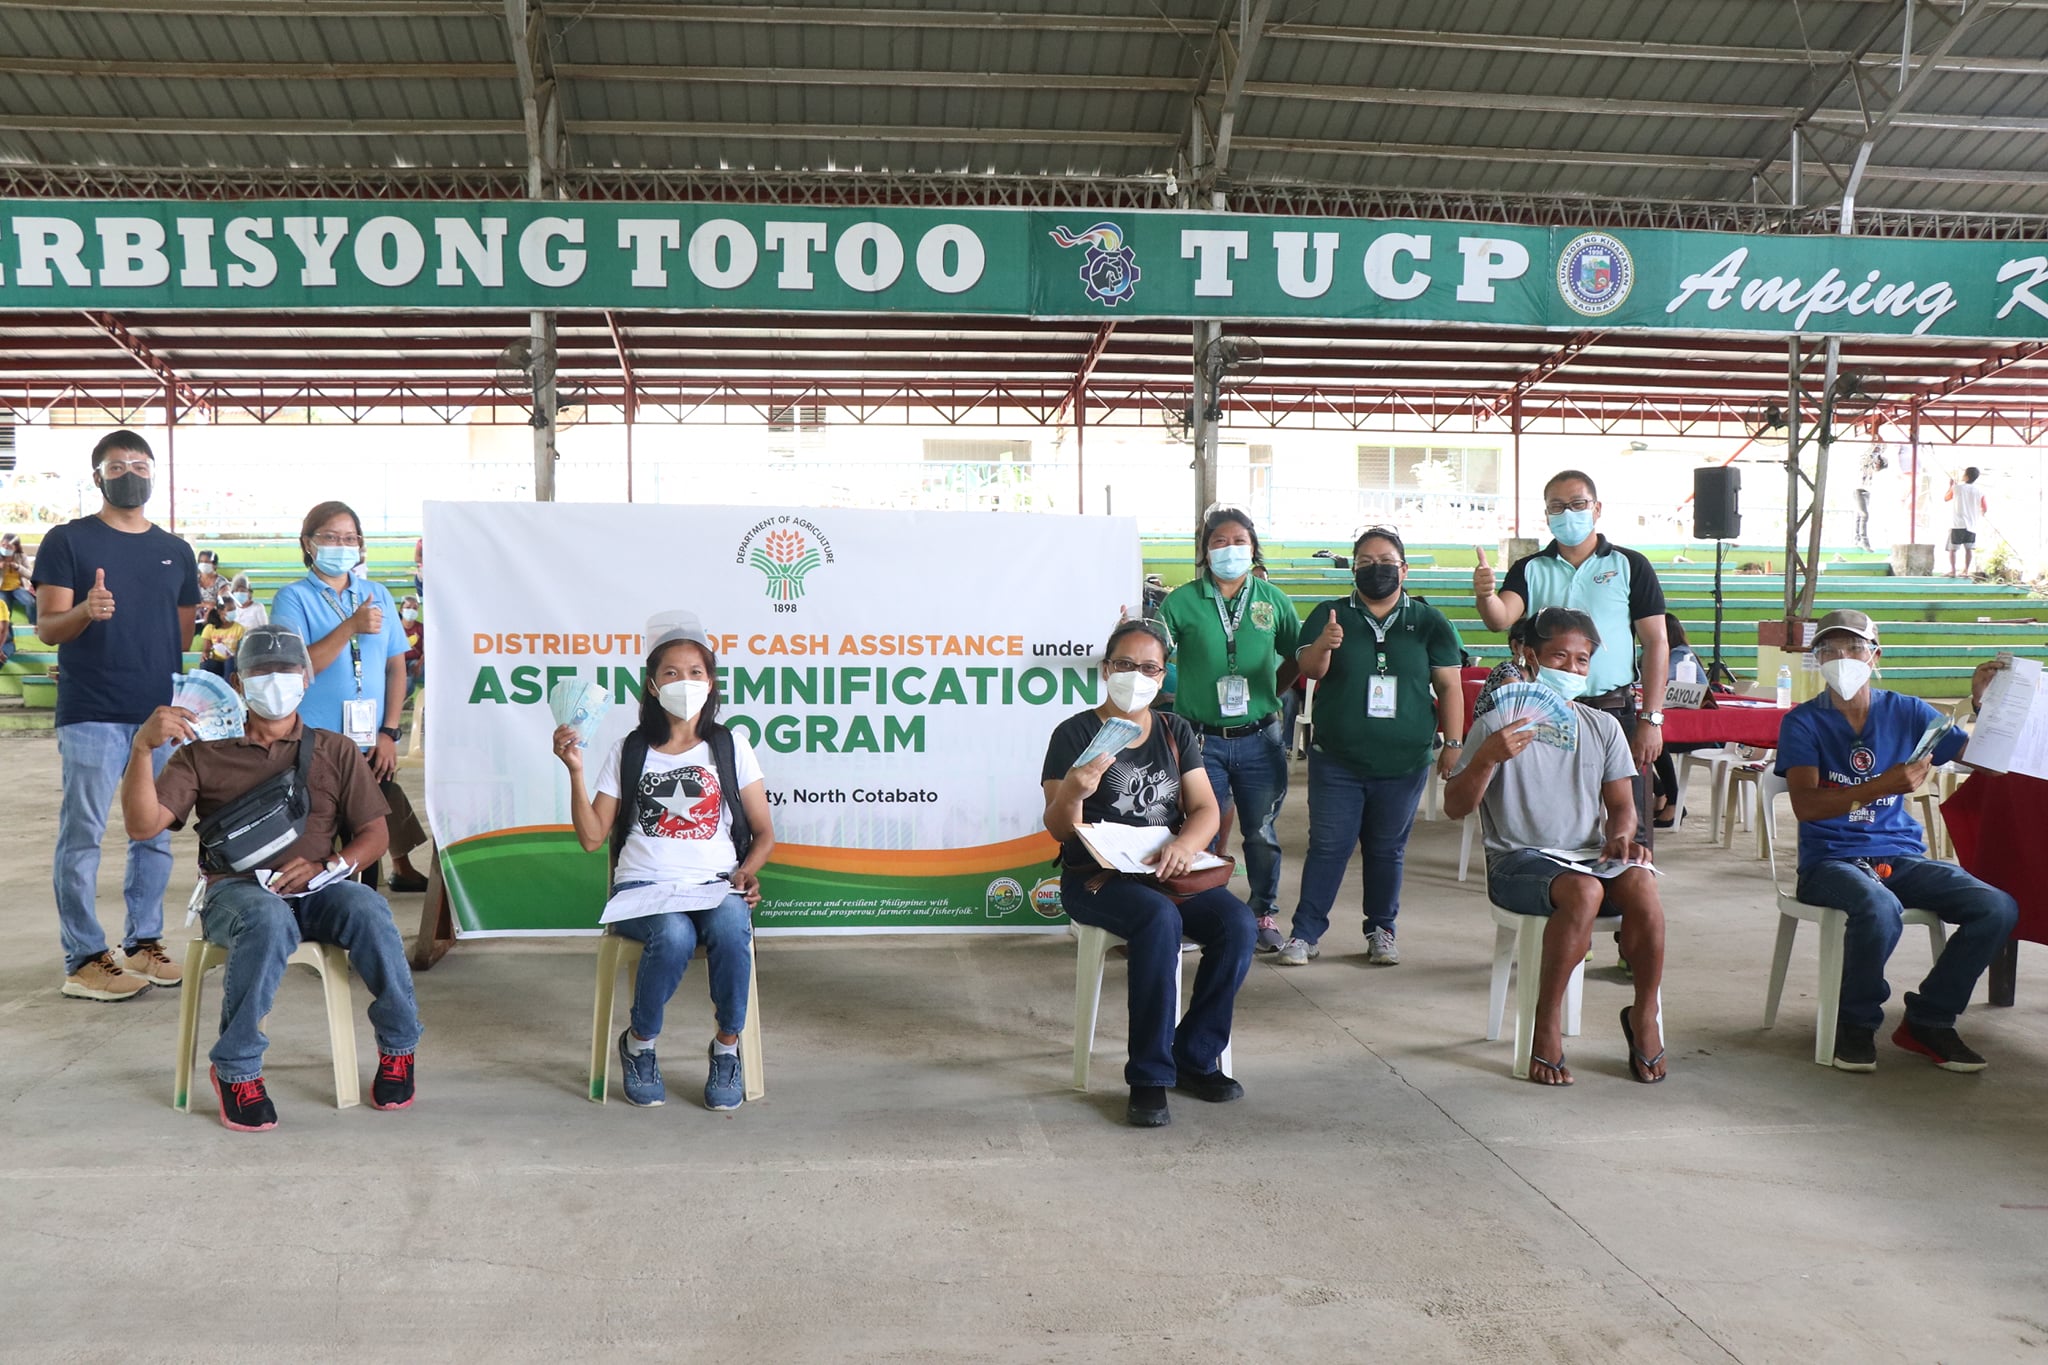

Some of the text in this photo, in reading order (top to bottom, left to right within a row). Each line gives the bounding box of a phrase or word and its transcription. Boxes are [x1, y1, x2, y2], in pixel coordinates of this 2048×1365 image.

[0, 216, 985, 294] RBISYONG TOTOO
[1561, 242, 1582, 285] LUNGSOD
[1600, 238, 1630, 286] KIDAPAWAN
[1665, 246, 1957, 335] Amping
[736, 515, 834, 564] DEPARTMENT OF AGRICULTURE
[773, 603, 797, 613] 1898
[473, 633, 641, 655] DISTRIBUTI
[747, 634, 829, 656] CASH
[838, 635, 1023, 656] ASSISTANCE
[1032, 640, 1094, 656] under
[597, 666, 1098, 705] INMNIFICATION
[1666, 687, 1701, 705] GAYOLA
[723, 714, 925, 754] OGRAM
[643, 772, 715, 796] CONVERSE
[1828, 770, 1861, 786] WORLD
[766, 789, 938, 806] ty, North Cotabato
[674, 822, 711, 840] STAR
[760, 908, 811, 918] empowered
[811, 908, 827, 916] and
[828, 908, 875, 917] prosperous
[875, 907, 911, 917] farmers
[824, 899, 840, 907] and
[843, 899, 877, 907] resilient
[880, 899, 927, 908] Philippines
